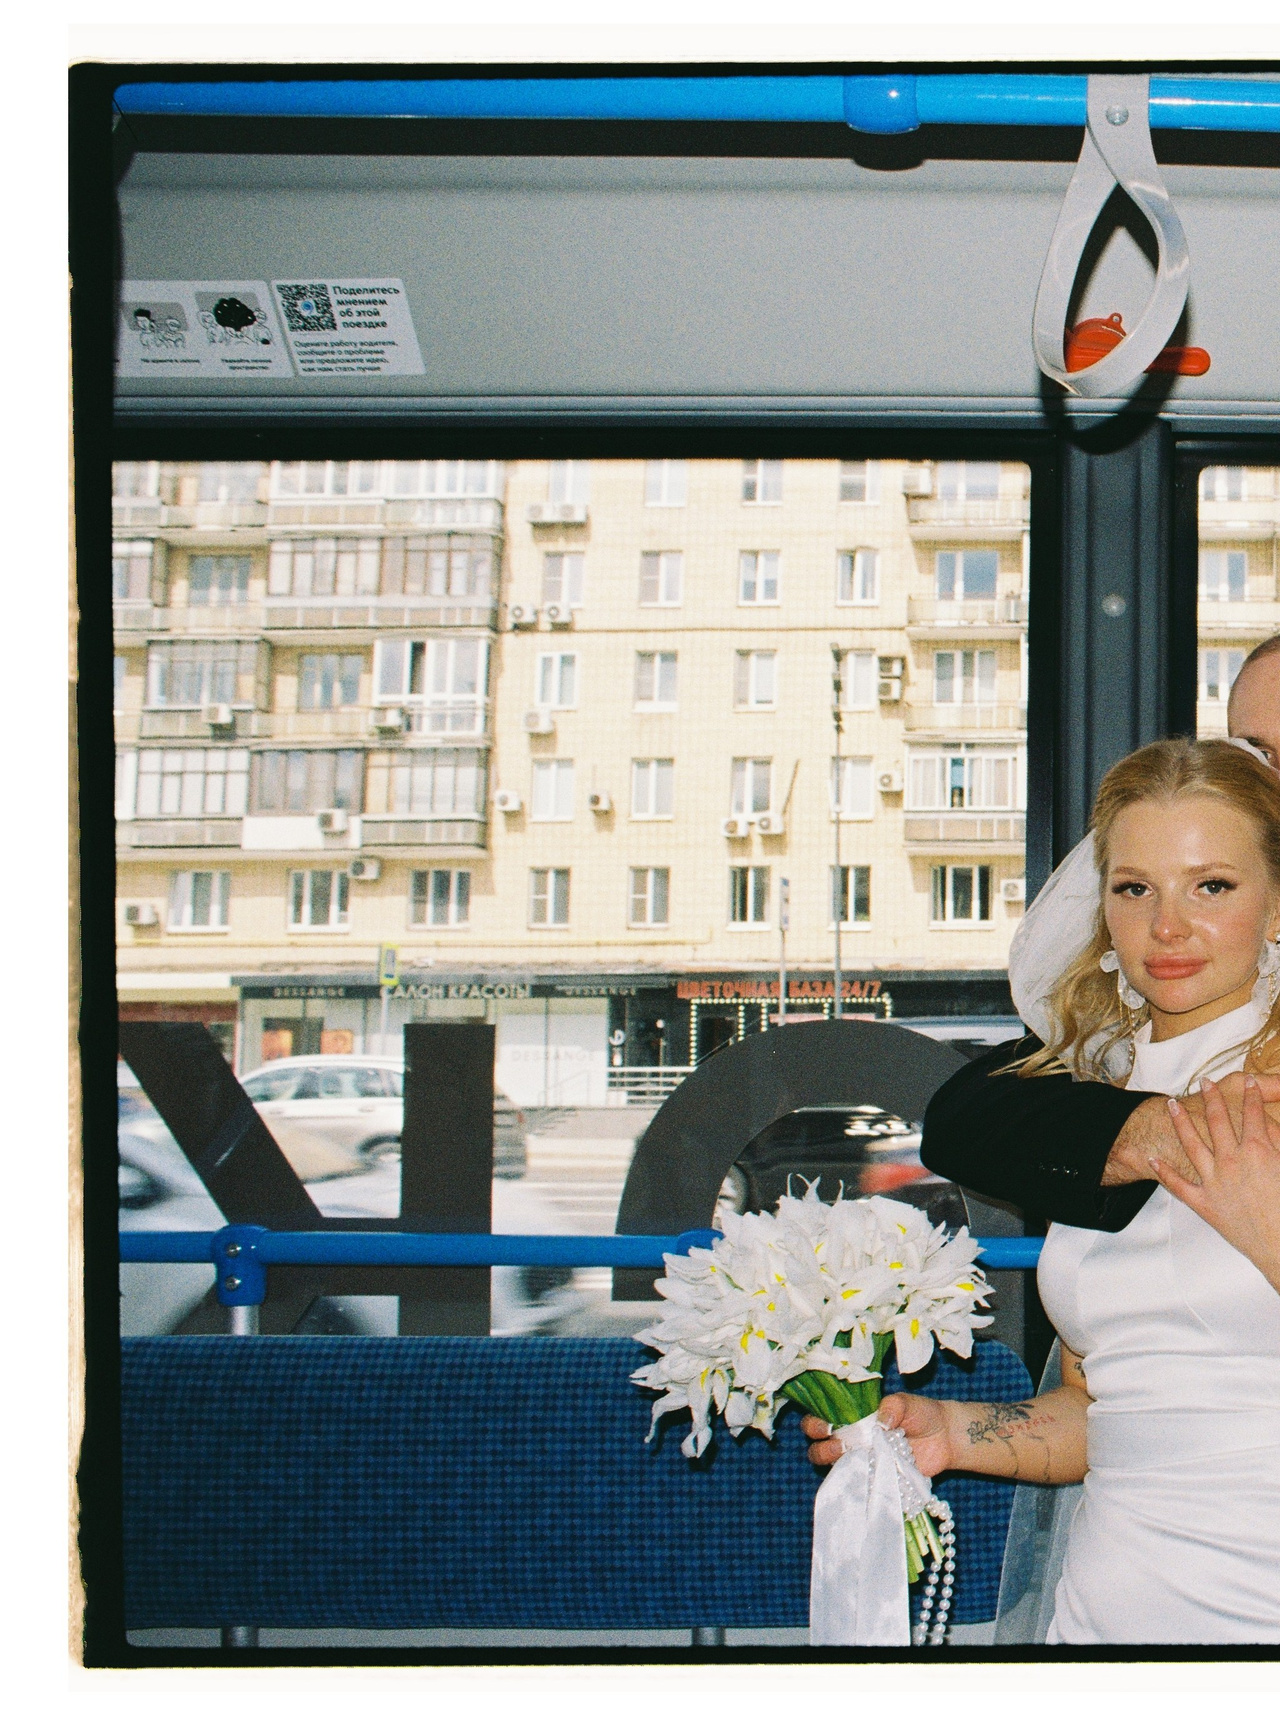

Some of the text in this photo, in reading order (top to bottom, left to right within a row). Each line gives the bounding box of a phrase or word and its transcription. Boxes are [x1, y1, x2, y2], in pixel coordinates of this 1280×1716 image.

[332, 286, 400, 296] Поделитесь
[340, 308, 381, 318] об этой
[342, 320, 388, 329] поездке
[380, 983, 531, 999] САЛОН КРАСОТЫ
[676, 980, 881, 999] ЦВЕТОЧНАЯ БАЗА 24/7
